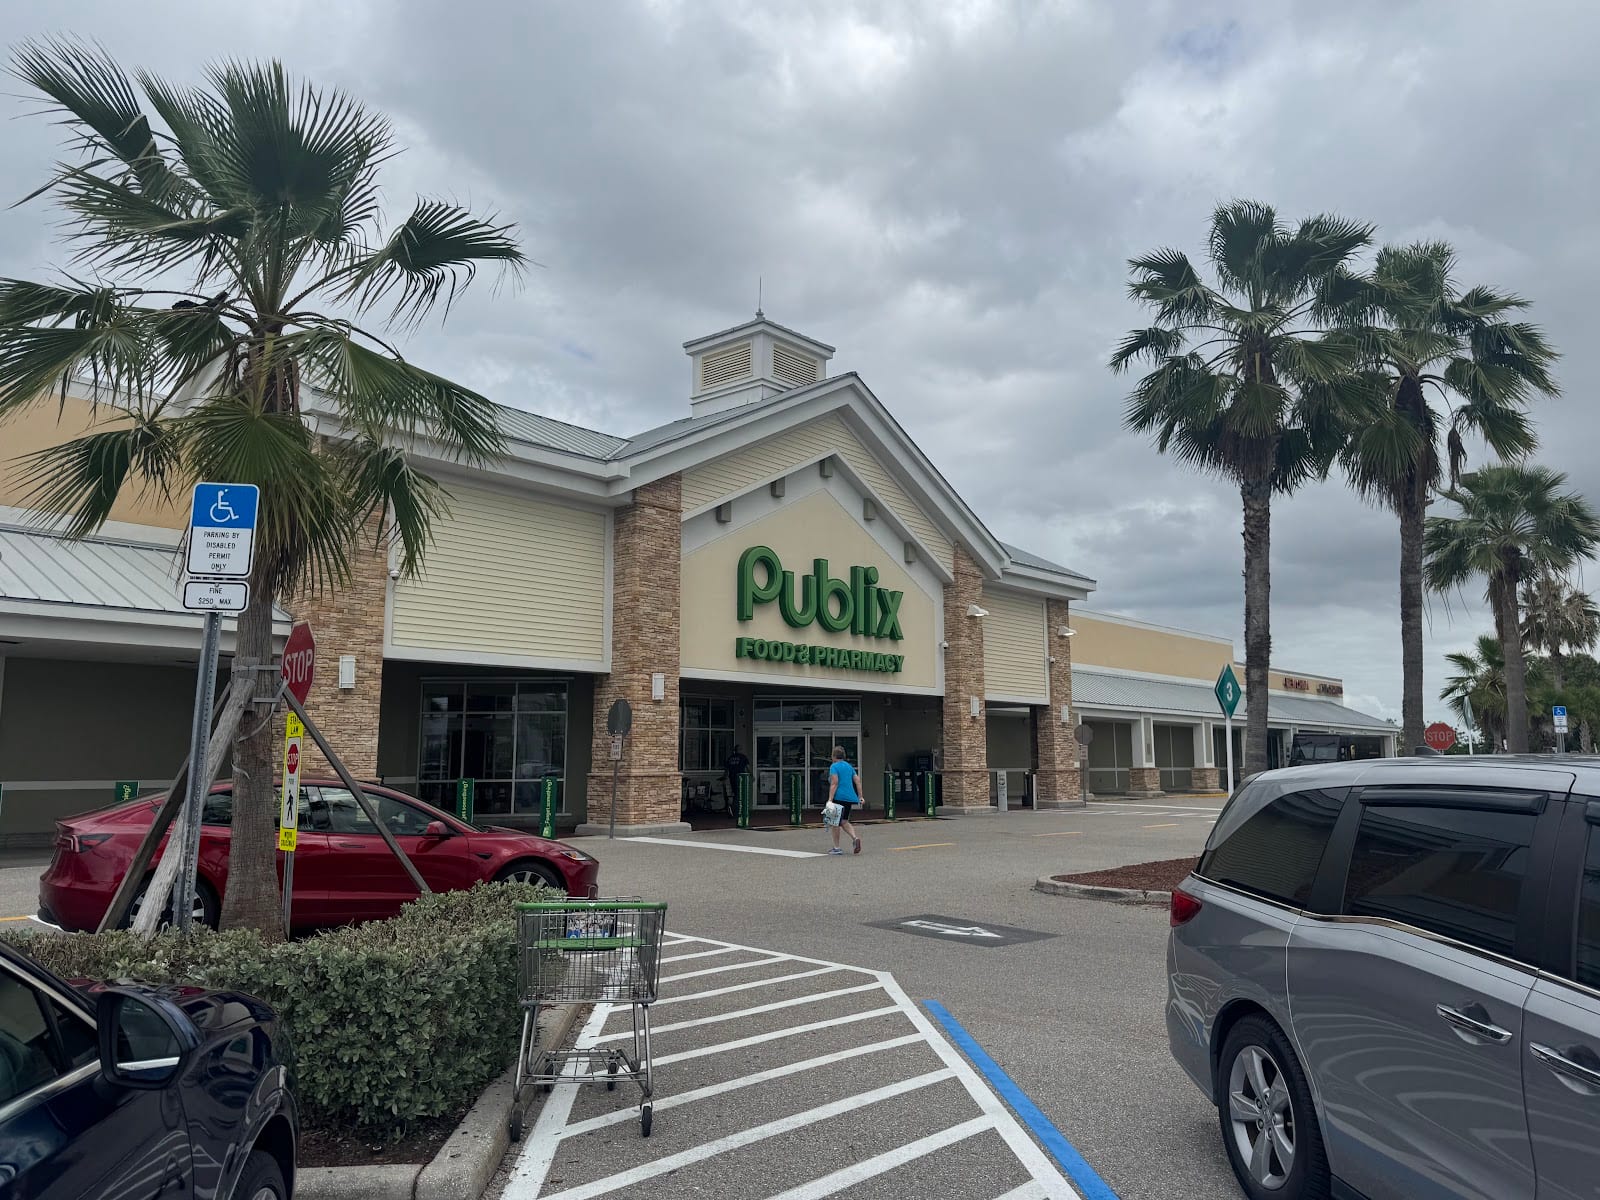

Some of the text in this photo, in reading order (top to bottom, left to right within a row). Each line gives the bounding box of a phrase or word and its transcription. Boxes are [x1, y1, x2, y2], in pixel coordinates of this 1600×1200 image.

[203, 531, 230, 539] PARKING
[206, 541, 236, 549] DISABLED
[208, 552, 231, 560] PERMIT
[209, 587, 223, 595] FINE
[737, 545, 904, 640] Publix
[198, 597, 214, 605] $250
[736, 637, 904, 673] FOOD & PHARMACY
[285, 648, 313, 684] STOP
[1226, 681, 1233, 702] 3
[1427, 731, 1451, 742] STOP
